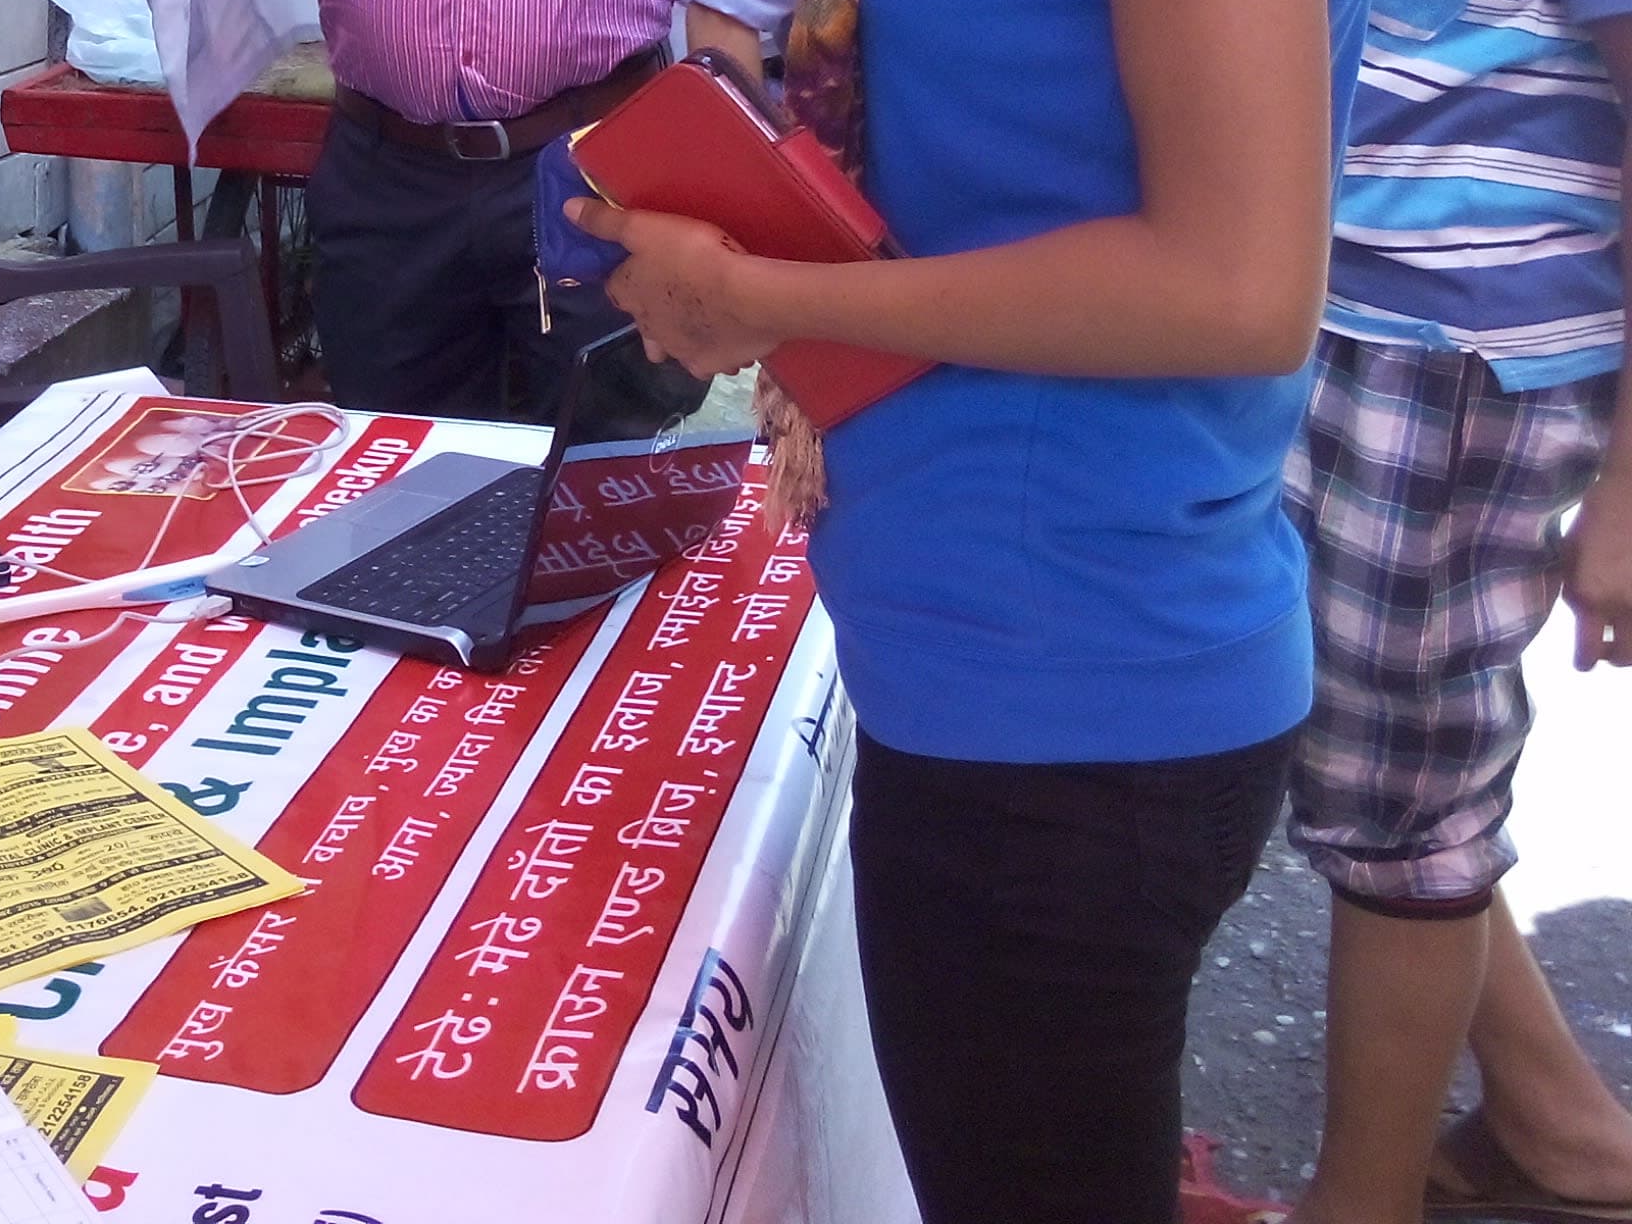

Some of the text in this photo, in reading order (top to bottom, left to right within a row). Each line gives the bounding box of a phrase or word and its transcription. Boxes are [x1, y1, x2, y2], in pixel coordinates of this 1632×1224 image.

[8, 507, 103, 583] ealth
[143, 642, 231, 707] and
[157, 628, 366, 817] & Impla
[422, 731, 495, 798] ज्यादा
[560, 760, 618, 810] का
[16, 836, 68, 856] CLINIC
[70, 819, 126, 839] IMPLANT
[120, 809, 170, 828] CENTER
[516, 962, 626, 1093] क्राउन
[585, 861, 666, 949] एण्ड
[758, 554, 808, 585] का
[142, 869, 251, 907] 9212254158
[156, 1000, 234, 1062] मुख
[401, 694, 448, 724] का
[644, 946, 756, 1150] समय
[38, 1073, 93, 1137] 212254158
